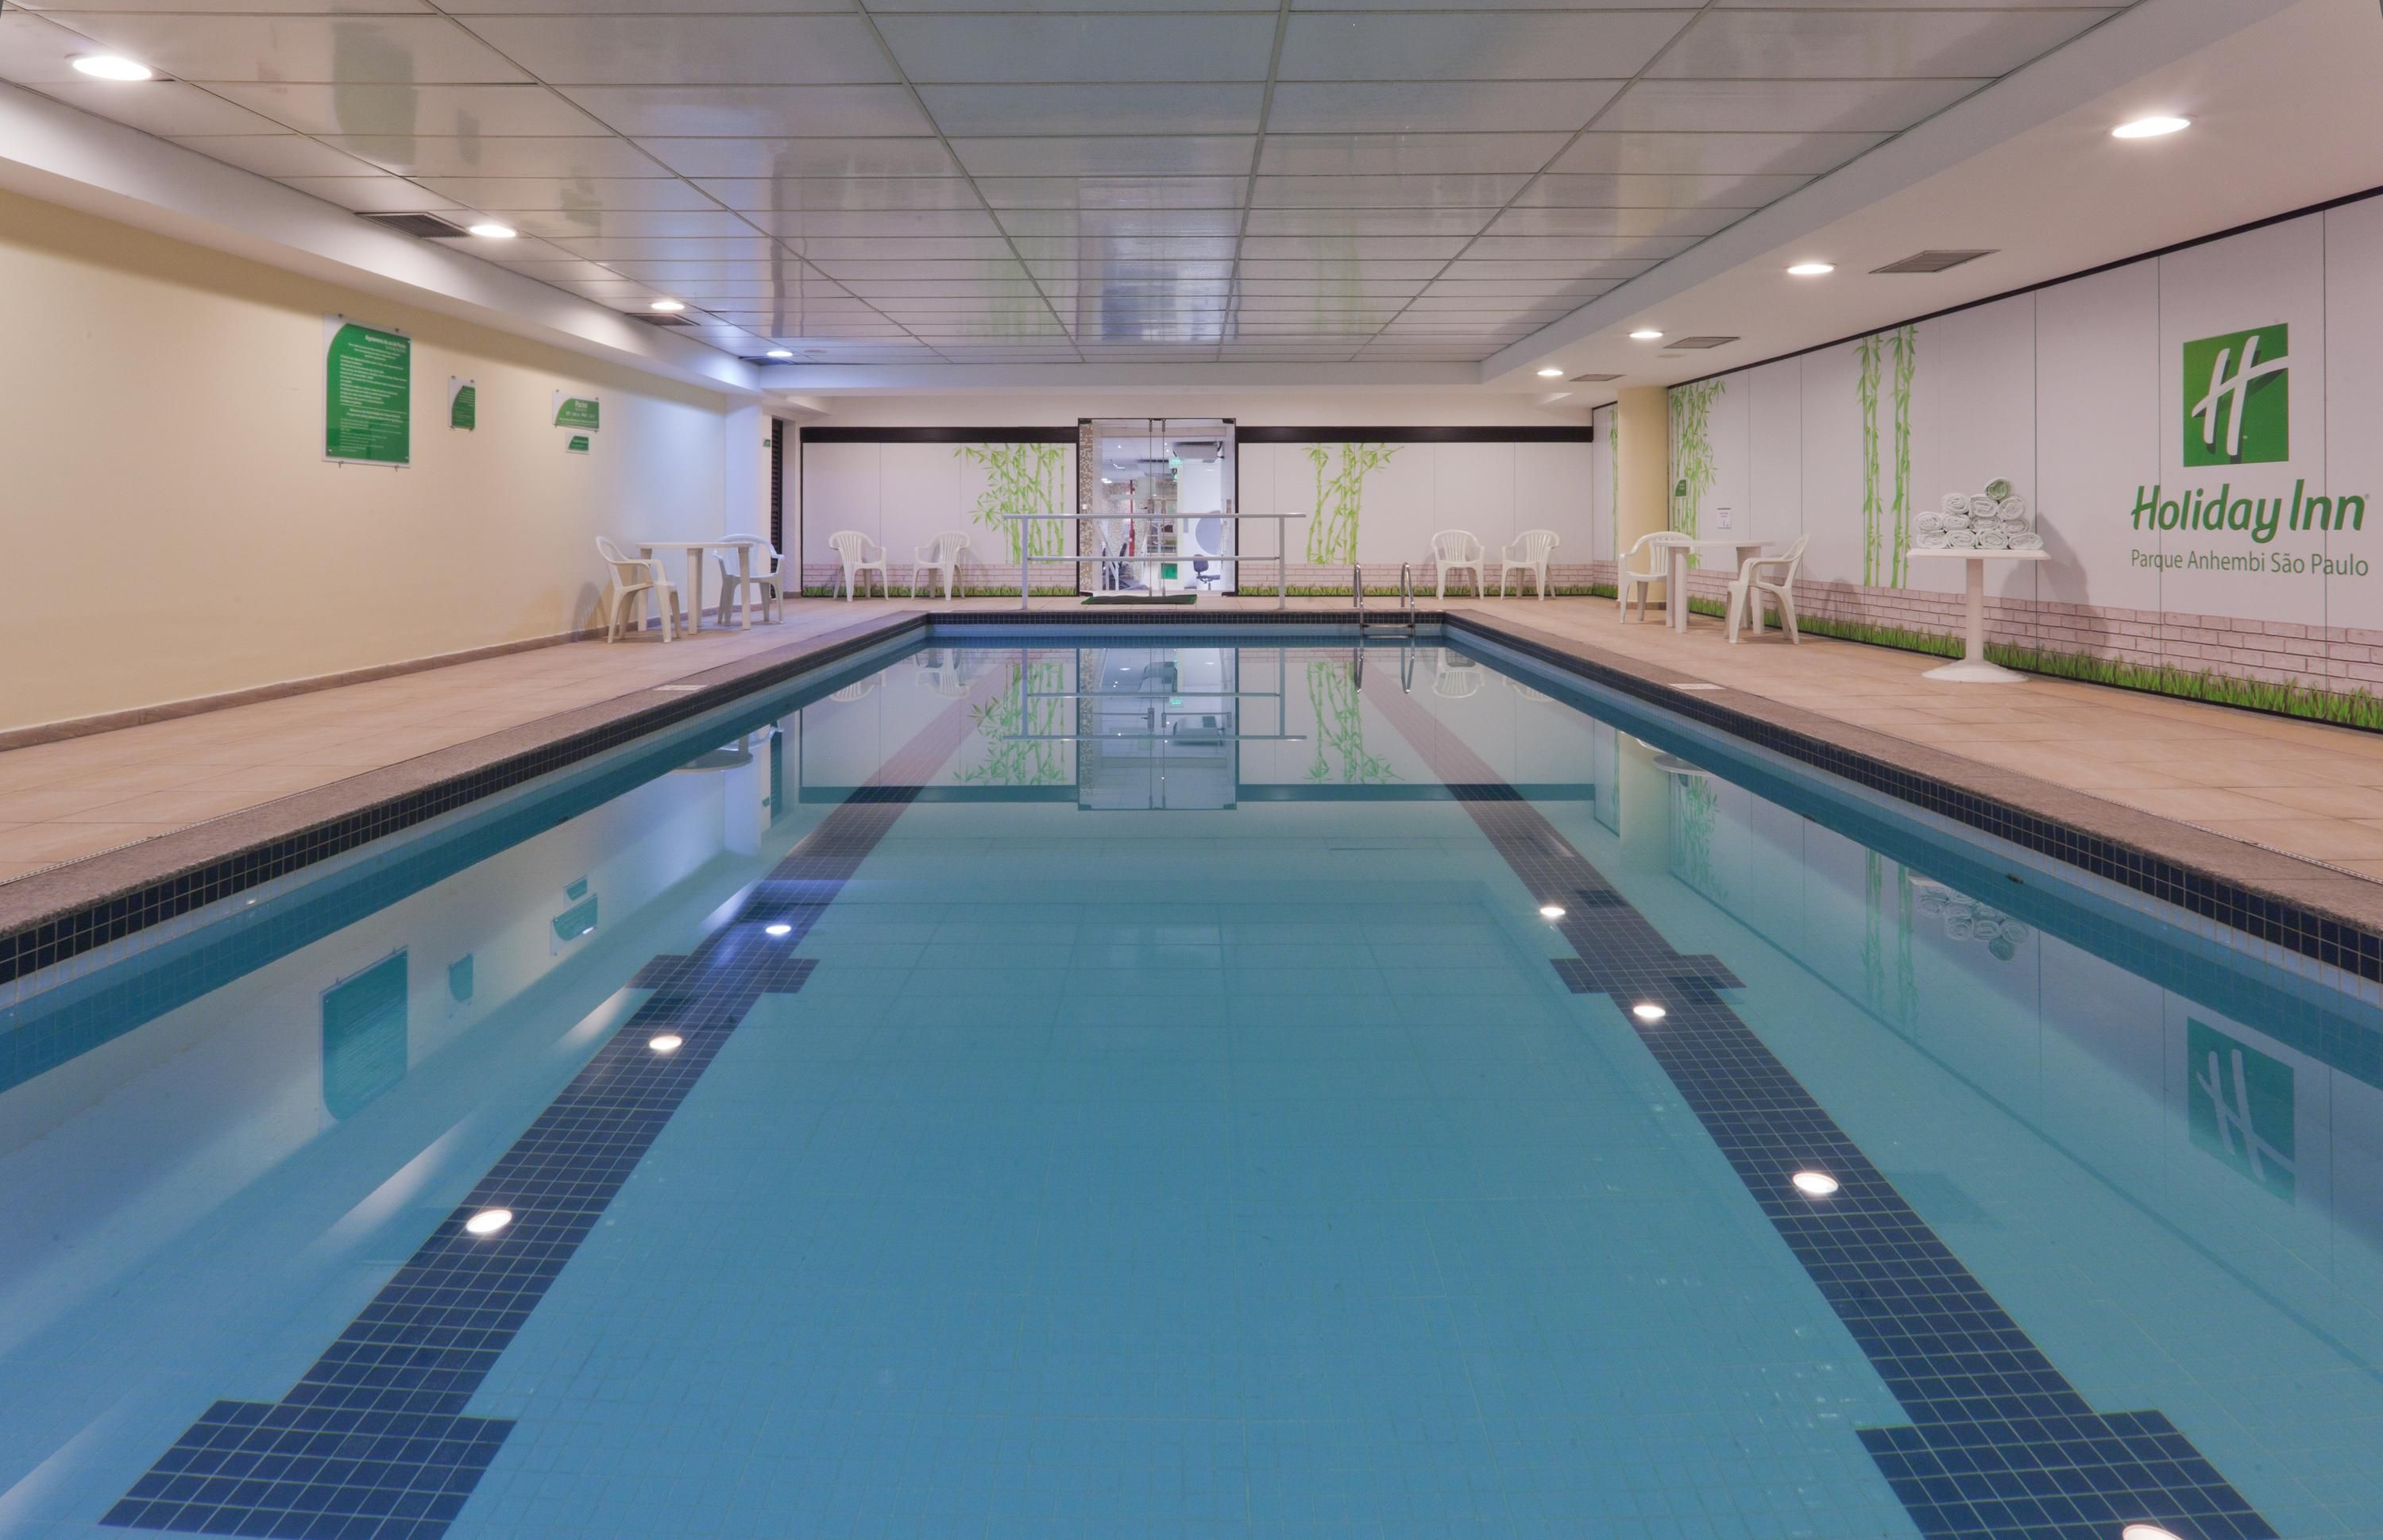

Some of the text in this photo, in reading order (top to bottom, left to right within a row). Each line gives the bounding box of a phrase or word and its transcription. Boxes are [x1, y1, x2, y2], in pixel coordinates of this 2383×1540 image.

[2130, 479, 2366, 543] Holiday Inn
[2131, 549, 2369, 576] Parque Anhembi São Paulo
